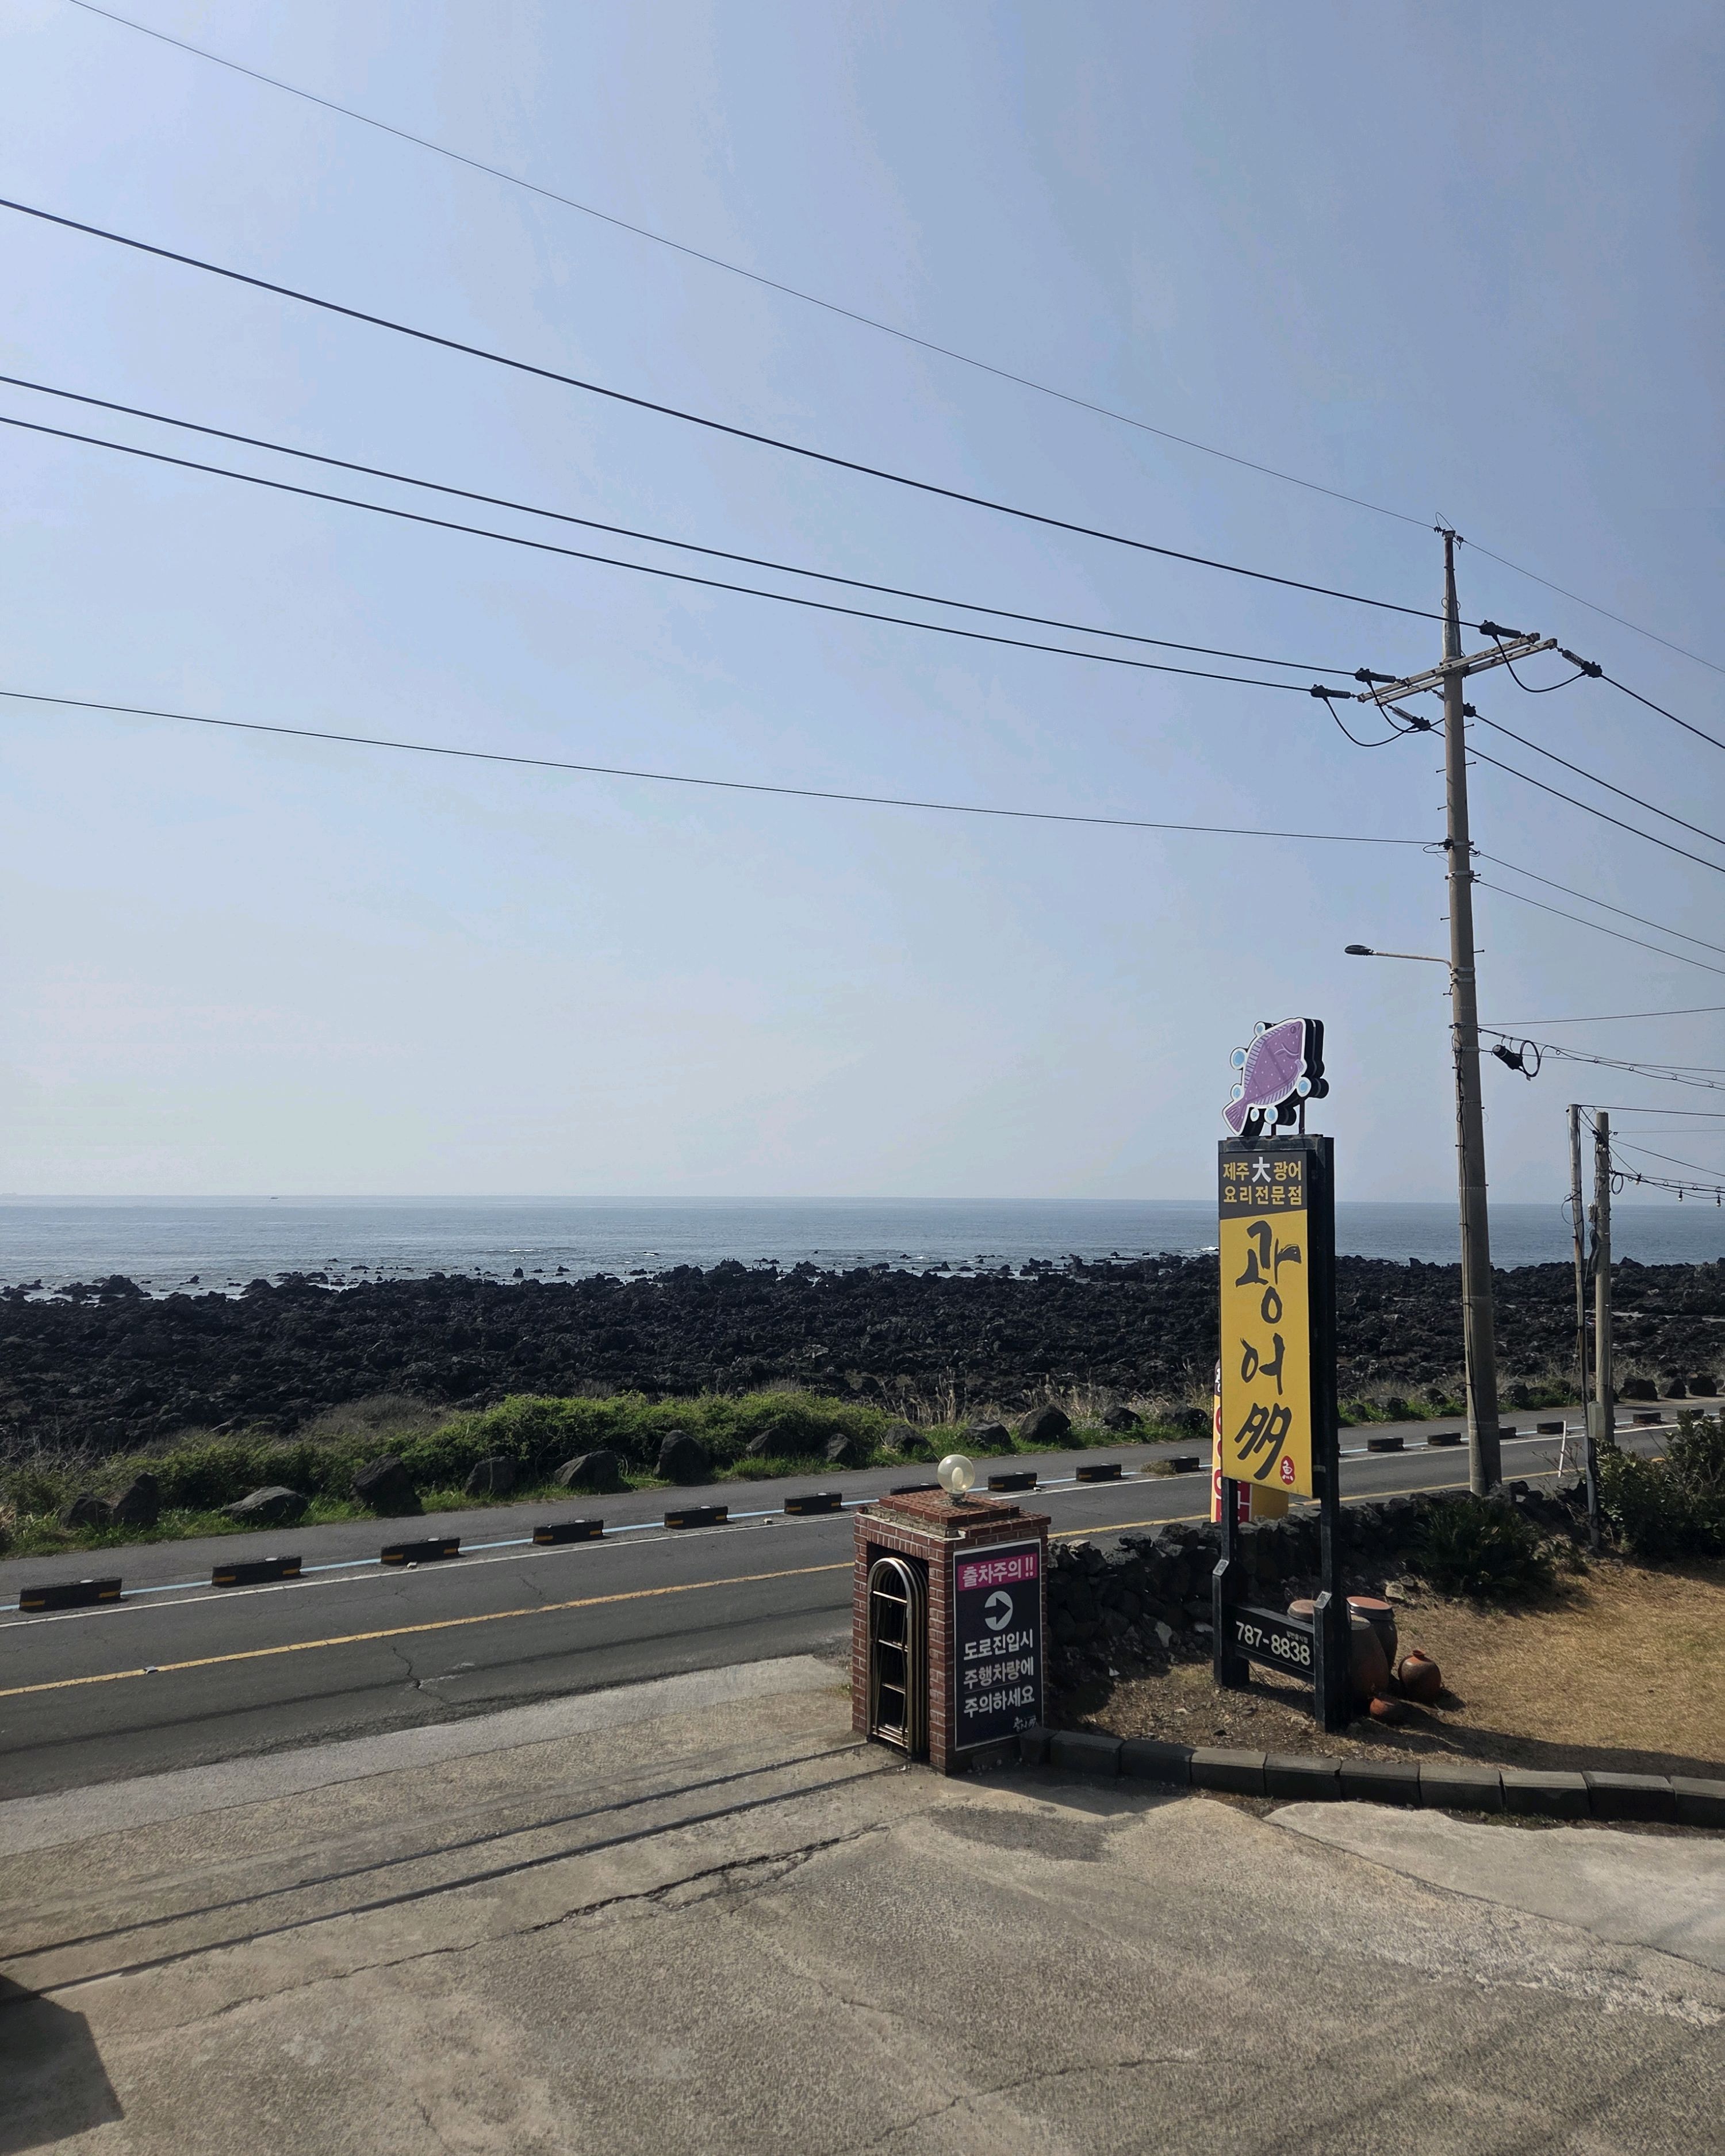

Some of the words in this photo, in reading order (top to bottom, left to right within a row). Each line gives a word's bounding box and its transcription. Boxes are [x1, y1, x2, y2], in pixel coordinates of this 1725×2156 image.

[1222, 1162, 1249, 1181] 제주
[1251, 1157, 1271, 1183] 大
[1273, 1161, 1302, 1181] 광어
[1223, 1186, 1302, 1206] 요리전문점
[963, 1628, 1033, 1661] 도로진입시
[1236, 1620, 1311, 1666] 787-8838
[963, 1656, 1034, 1690] 주행차량에
[963, 1685, 1035, 1718] 주의하세요
